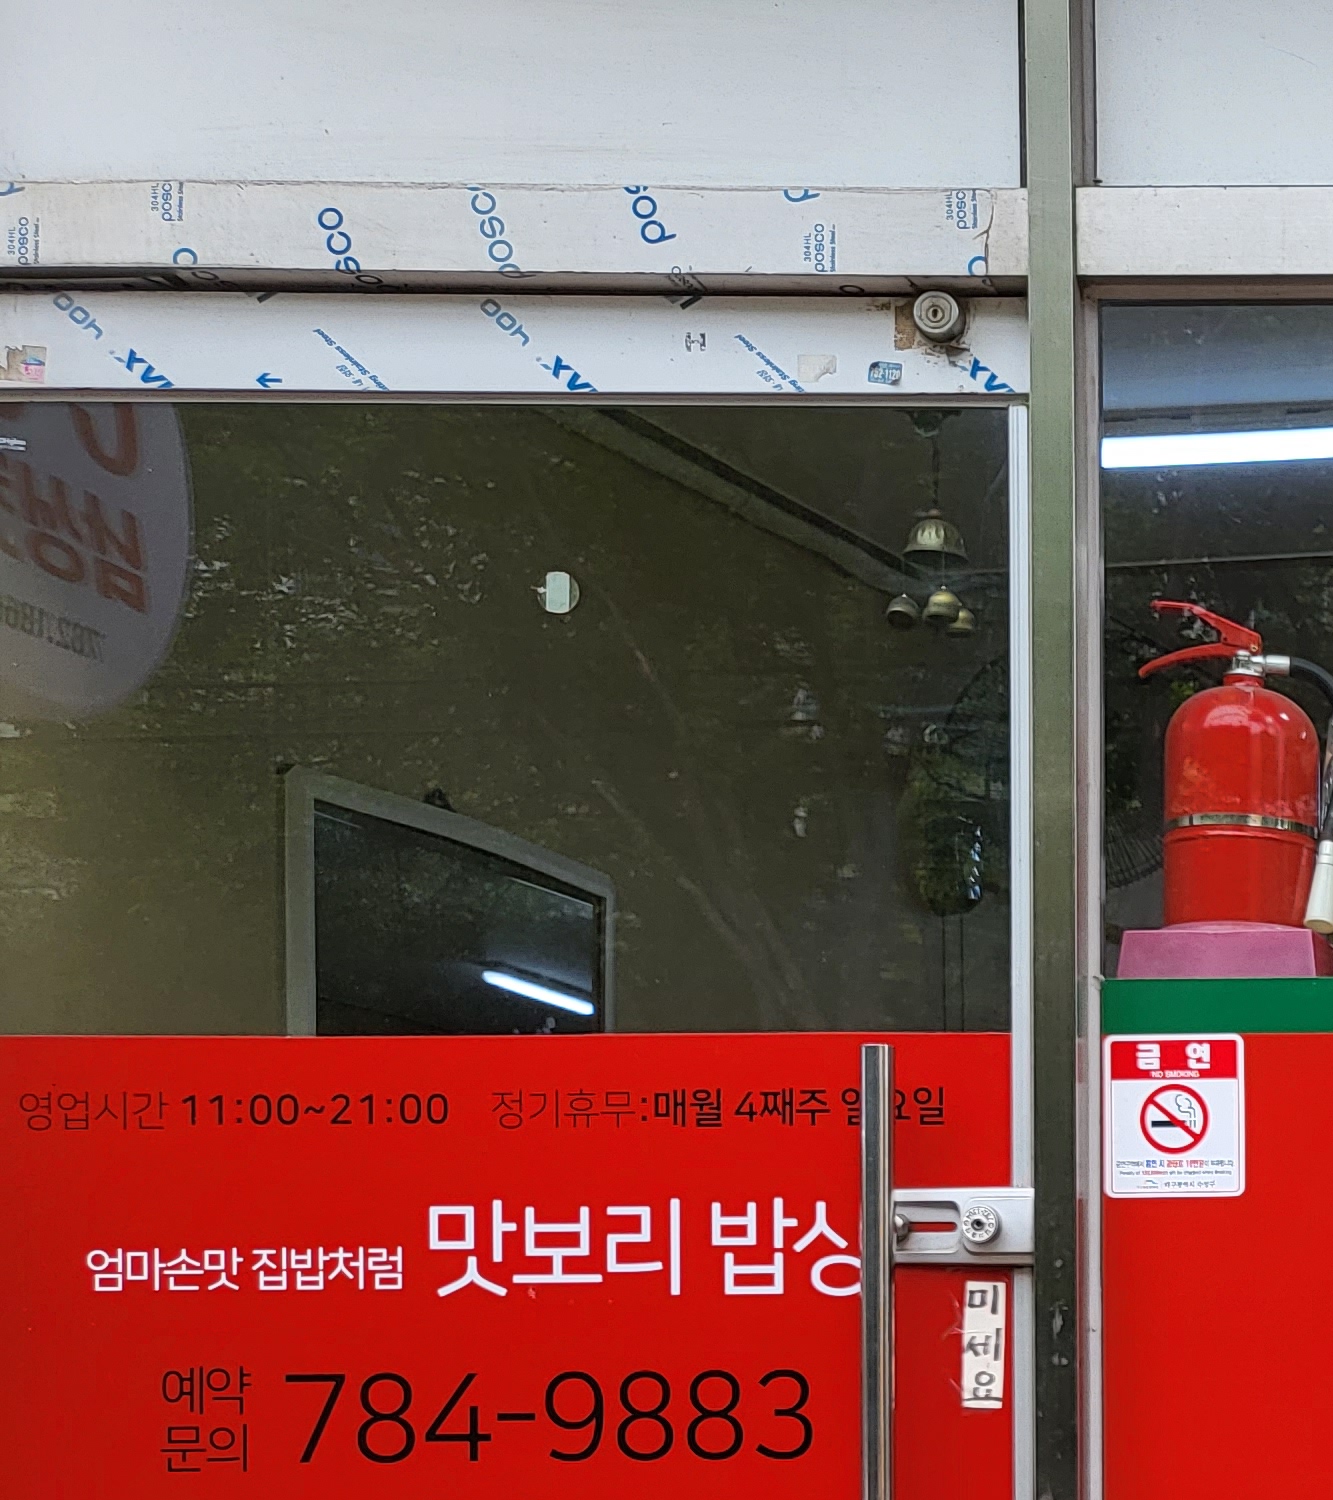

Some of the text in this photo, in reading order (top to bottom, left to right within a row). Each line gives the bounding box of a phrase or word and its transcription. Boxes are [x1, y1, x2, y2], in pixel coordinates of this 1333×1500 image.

[18, 216, 31, 265] posco
[803, 232, 812, 262] 304HL
[814, 223, 828, 272] posco
[480, 299, 531, 347] 400
[20, 1091, 449, 1132] 영업시간 11:00~21:00
[734, 1088, 831, 1127] 4째주
[86, 1247, 244, 1292] 엄마손맛
[251, 1246, 403, 1291] 집밥처럼
[428, 1198, 681, 1297] 맛보리
[964, 1284, 1003, 1402] 미세요
[162, 1366, 252, 1415] 예약
[285, 1369, 813, 1464] 784-9883
[160, 1423, 248, 1473] 문의
